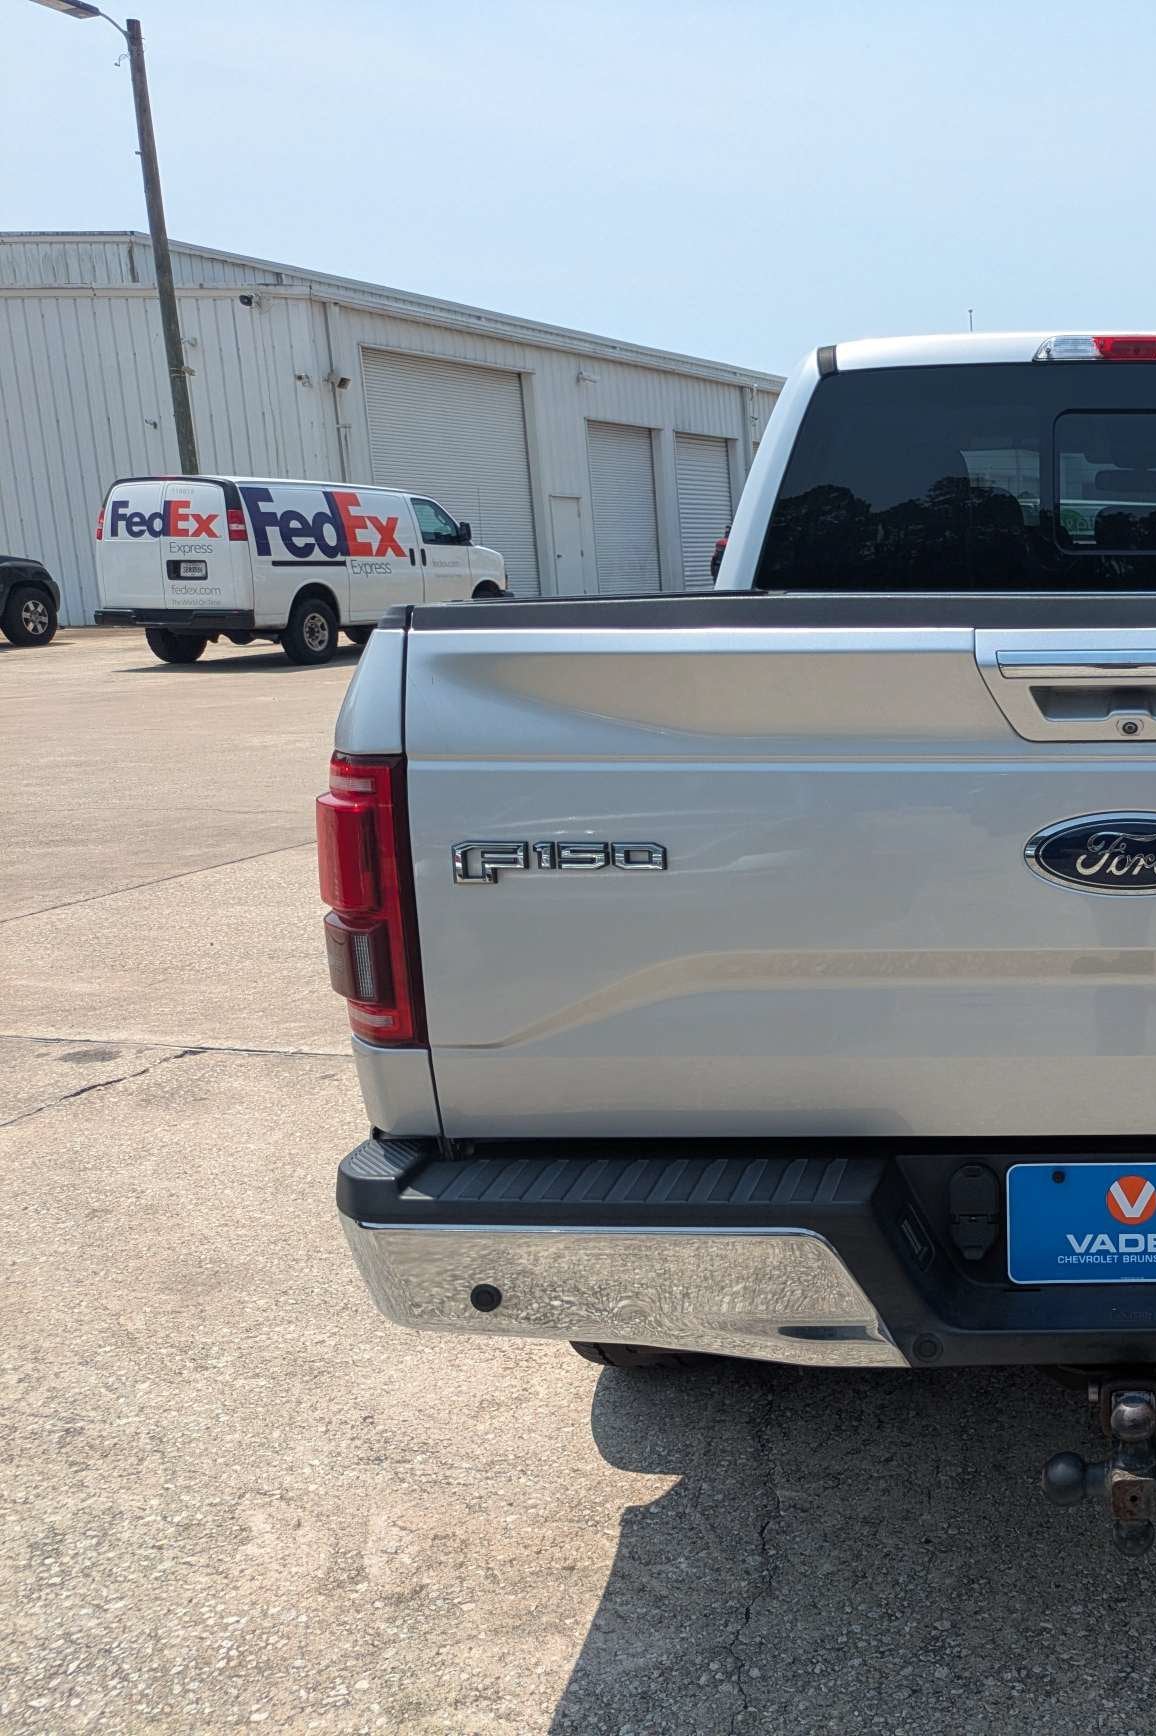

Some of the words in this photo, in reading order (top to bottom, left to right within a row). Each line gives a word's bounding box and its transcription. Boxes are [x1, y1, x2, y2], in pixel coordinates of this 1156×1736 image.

[111, 500, 221, 539] FedEx
[240, 486, 407, 559] FedEx
[169, 541, 213, 556] Express
[351, 559, 392, 578] Express
[171, 584, 221, 595] fedex.com
[1057, 1254, 1119, 1264] CHEVROLET
